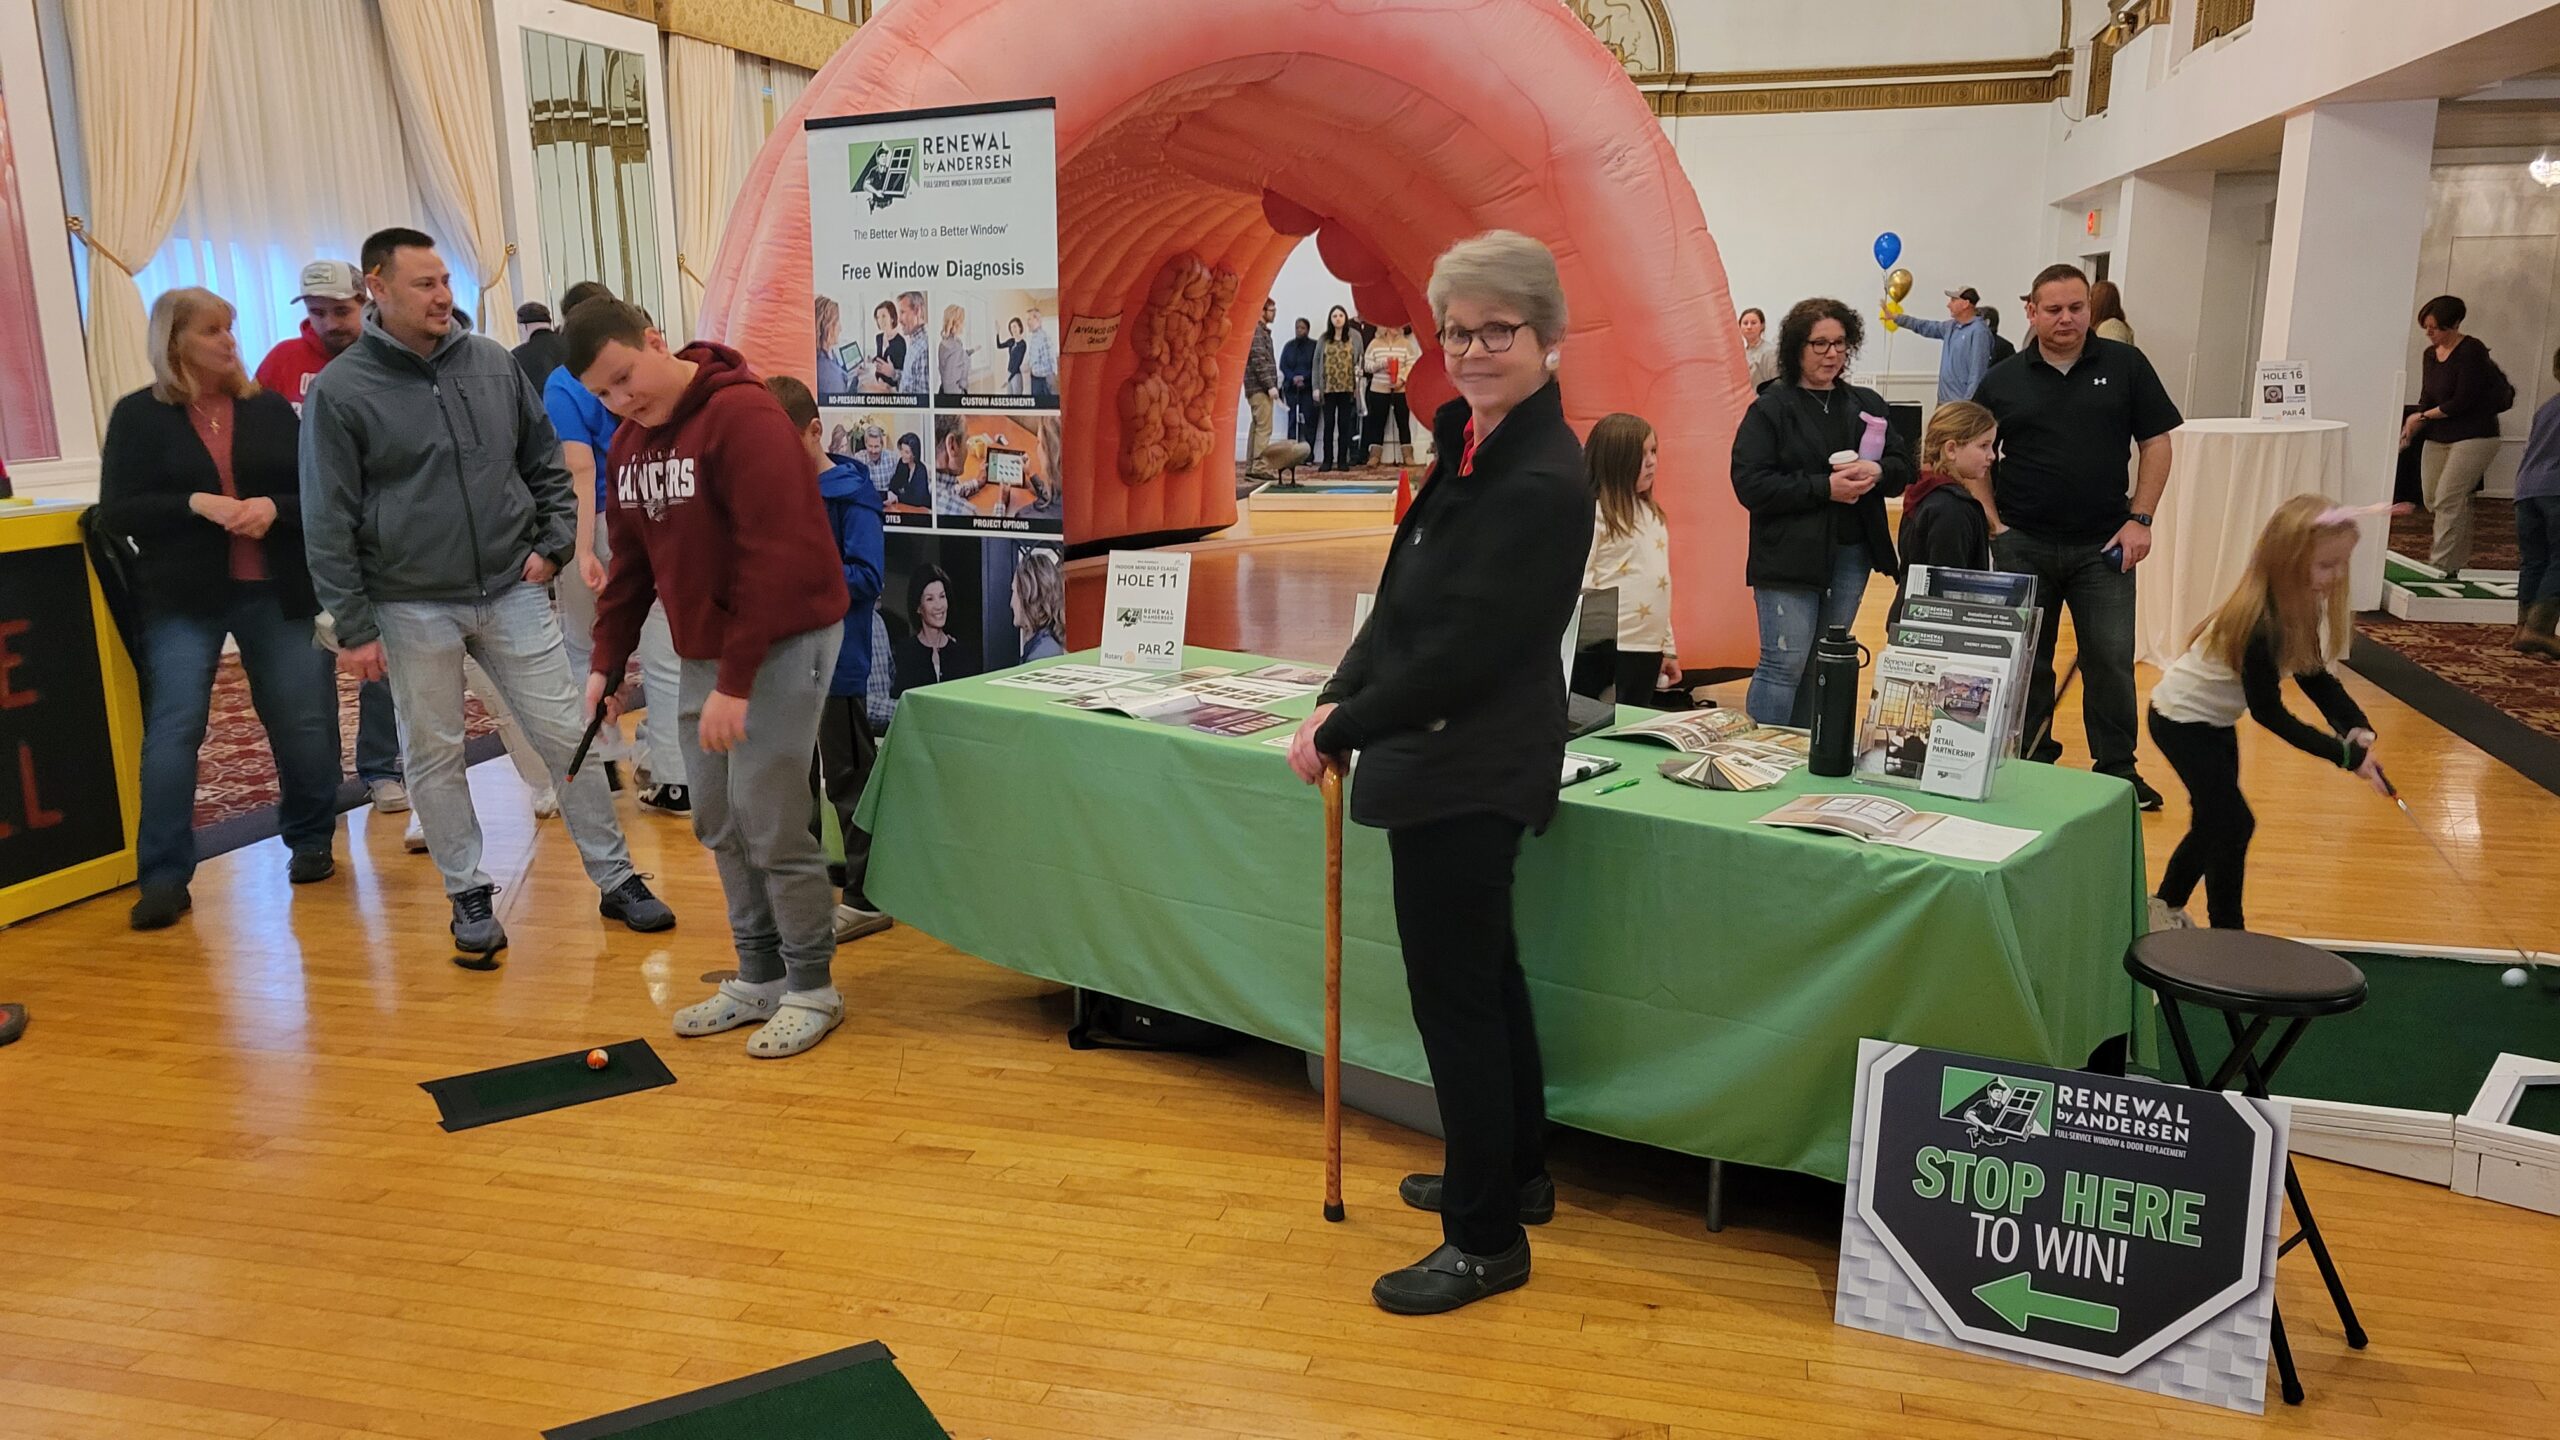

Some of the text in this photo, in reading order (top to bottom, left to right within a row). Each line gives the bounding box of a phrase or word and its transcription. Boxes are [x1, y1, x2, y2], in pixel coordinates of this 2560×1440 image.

[923, 131, 1011, 154] RENEWAL
[923, 153, 1012, 173] by ANDERSEN
[854, 229, 868, 240] The
[870, 228, 897, 239] Better
[900, 227, 918, 240] Way
[920, 226, 929, 238] to
[931, 228, 937, 236] a
[940, 226, 968, 236] Better
[842, 258, 1024, 281] Free Window Diagnosis
[2263, 370, 2303, 380] HOLE 16
[866, 396, 918, 405] CONSULTATIONS
[961, 397, 1036, 407] CUSTOM ASSESSMENTS
[2299, 407, 2305, 416] 4
[973, 519, 1029, 530] PROJECT OPTIONS
[1117, 573, 1177, 589] HOLE 11
[1143, 607, 1174, 615] RENEWAL
[1138, 641, 1175, 656] PAR 2
[1105, 653, 1123, 661] Rotary
[1883, 656, 1914, 668] Renewal
[1933, 737, 1954, 747] RETAIL
[1932, 745, 1976, 759] PARTNERSHIP
[2058, 1085, 2190, 1125] RENEWAL
[2056, 1107, 2189, 1143] by ANDERSEN
[2055, 1129, 2187, 1159] FULL-SERVICE WINDOW & DOOR REPLACEMENT
[1911, 1145, 2207, 1248] STOP HERE
[1970, 1211, 2129, 1286] TO WIN!
